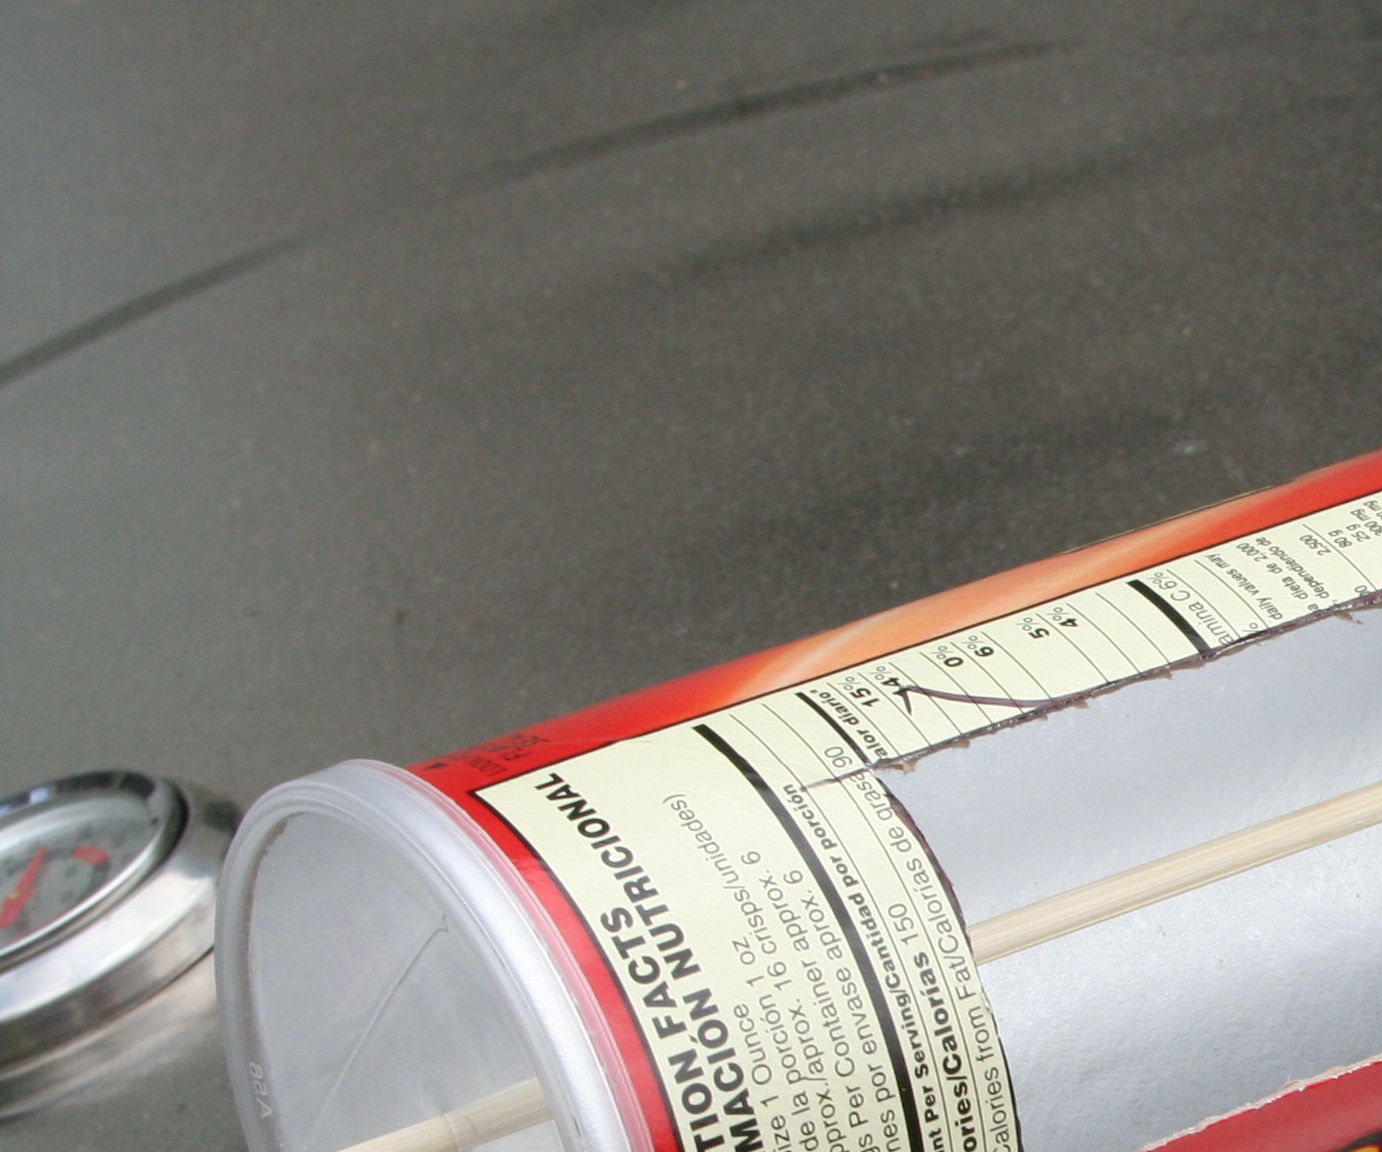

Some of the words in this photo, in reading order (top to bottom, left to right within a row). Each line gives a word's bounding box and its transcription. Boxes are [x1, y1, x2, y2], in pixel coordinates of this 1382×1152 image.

[1205, 553, 1230, 569] may
[1226, 568, 1260, 596] values
[1281, 576, 1308, 600] dieta
[1257, 597, 1283, 621] daily
[823, 746, 852, 768] 90
[783, 783, 838, 850] porción
[741, 851, 761, 865] 6
[888, 826, 912, 852] de
[535, 772, 701, 980] NUTRICIONAL
[663, 793, 777, 955] crisps/unidades)
[783, 870, 803, 885] 6
[830, 856, 858, 887] por
[758, 869, 810, 952] approx.
[801, 890, 843, 960] aprox.
[887, 902, 919, 946] 150
[906, 858, 976, 1000] Fat/Calorías
[731, 936, 756, 965] oz
[600, 907, 687, 1039] FACTS
[767, 961, 792, 991] 16
[848, 892, 929, 1079] Serving/Cantidad
[801, 960, 855, 1077] Container
[836, 966, 876, 1055] envase
[733, 1003, 772, 1085] Ounce
[759, 993, 804, 1085] porción
[968, 1006, 993, 1062] from
[792, 1090, 811, 1116] la
[867, 1064, 896, 1103] por
[921, 1085, 940, 1123] Per
[845, 1085, 868, 1128] Per
[799, 1120, 820, 1152] de
